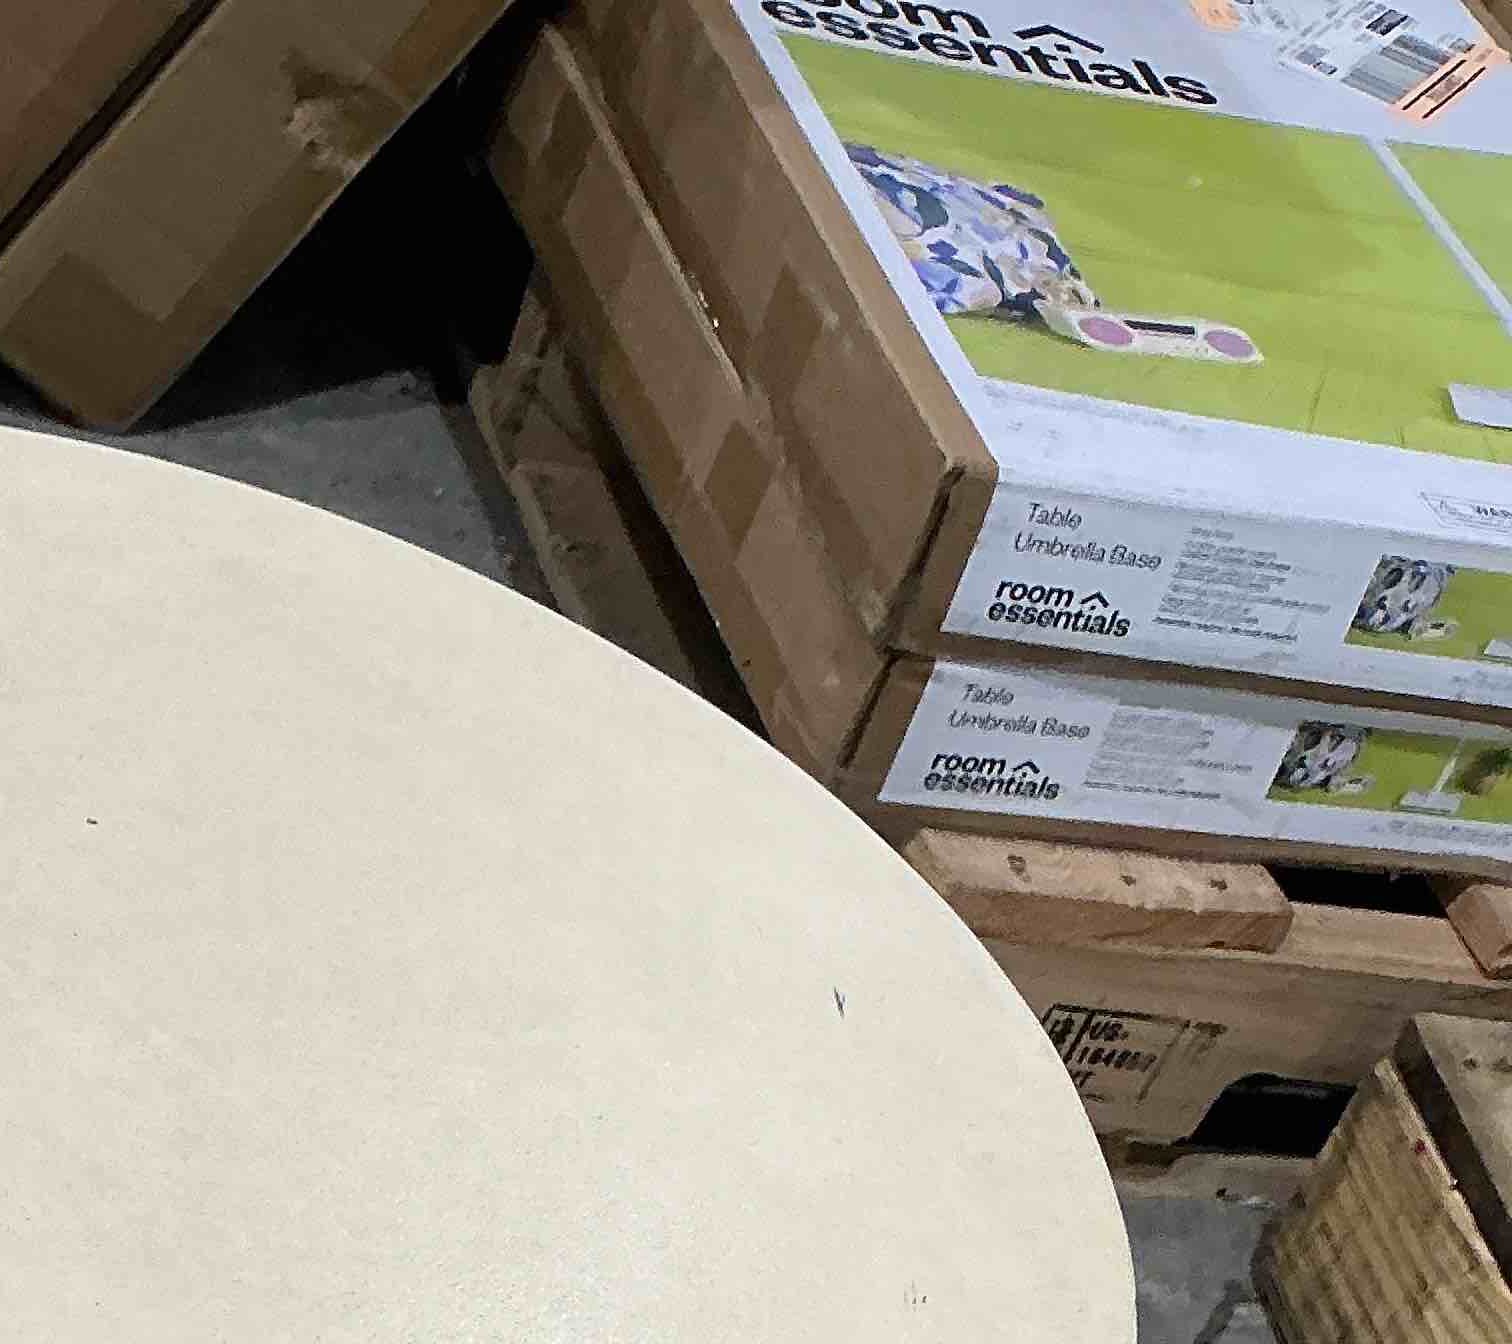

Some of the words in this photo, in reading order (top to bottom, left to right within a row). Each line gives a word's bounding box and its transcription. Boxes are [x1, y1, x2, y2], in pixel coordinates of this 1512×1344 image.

[800, 0, 991, 38] om
[761, 1, 1218, 105] essentials
[1027, 502, 1082, 530] Table
[1014, 531, 1105, 561] Umbrella
[1108, 543, 1162, 571] Base
[995, 580, 1075, 608] room
[987, 602, 1131, 637] essentials
[962, 683, 1015, 706] Table
[948, 708, 1037, 734] Umbrella
[1040, 716, 1091, 739] Base
[930, 753, 1006, 776] room
[924, 772, 1061, 801] essentials
